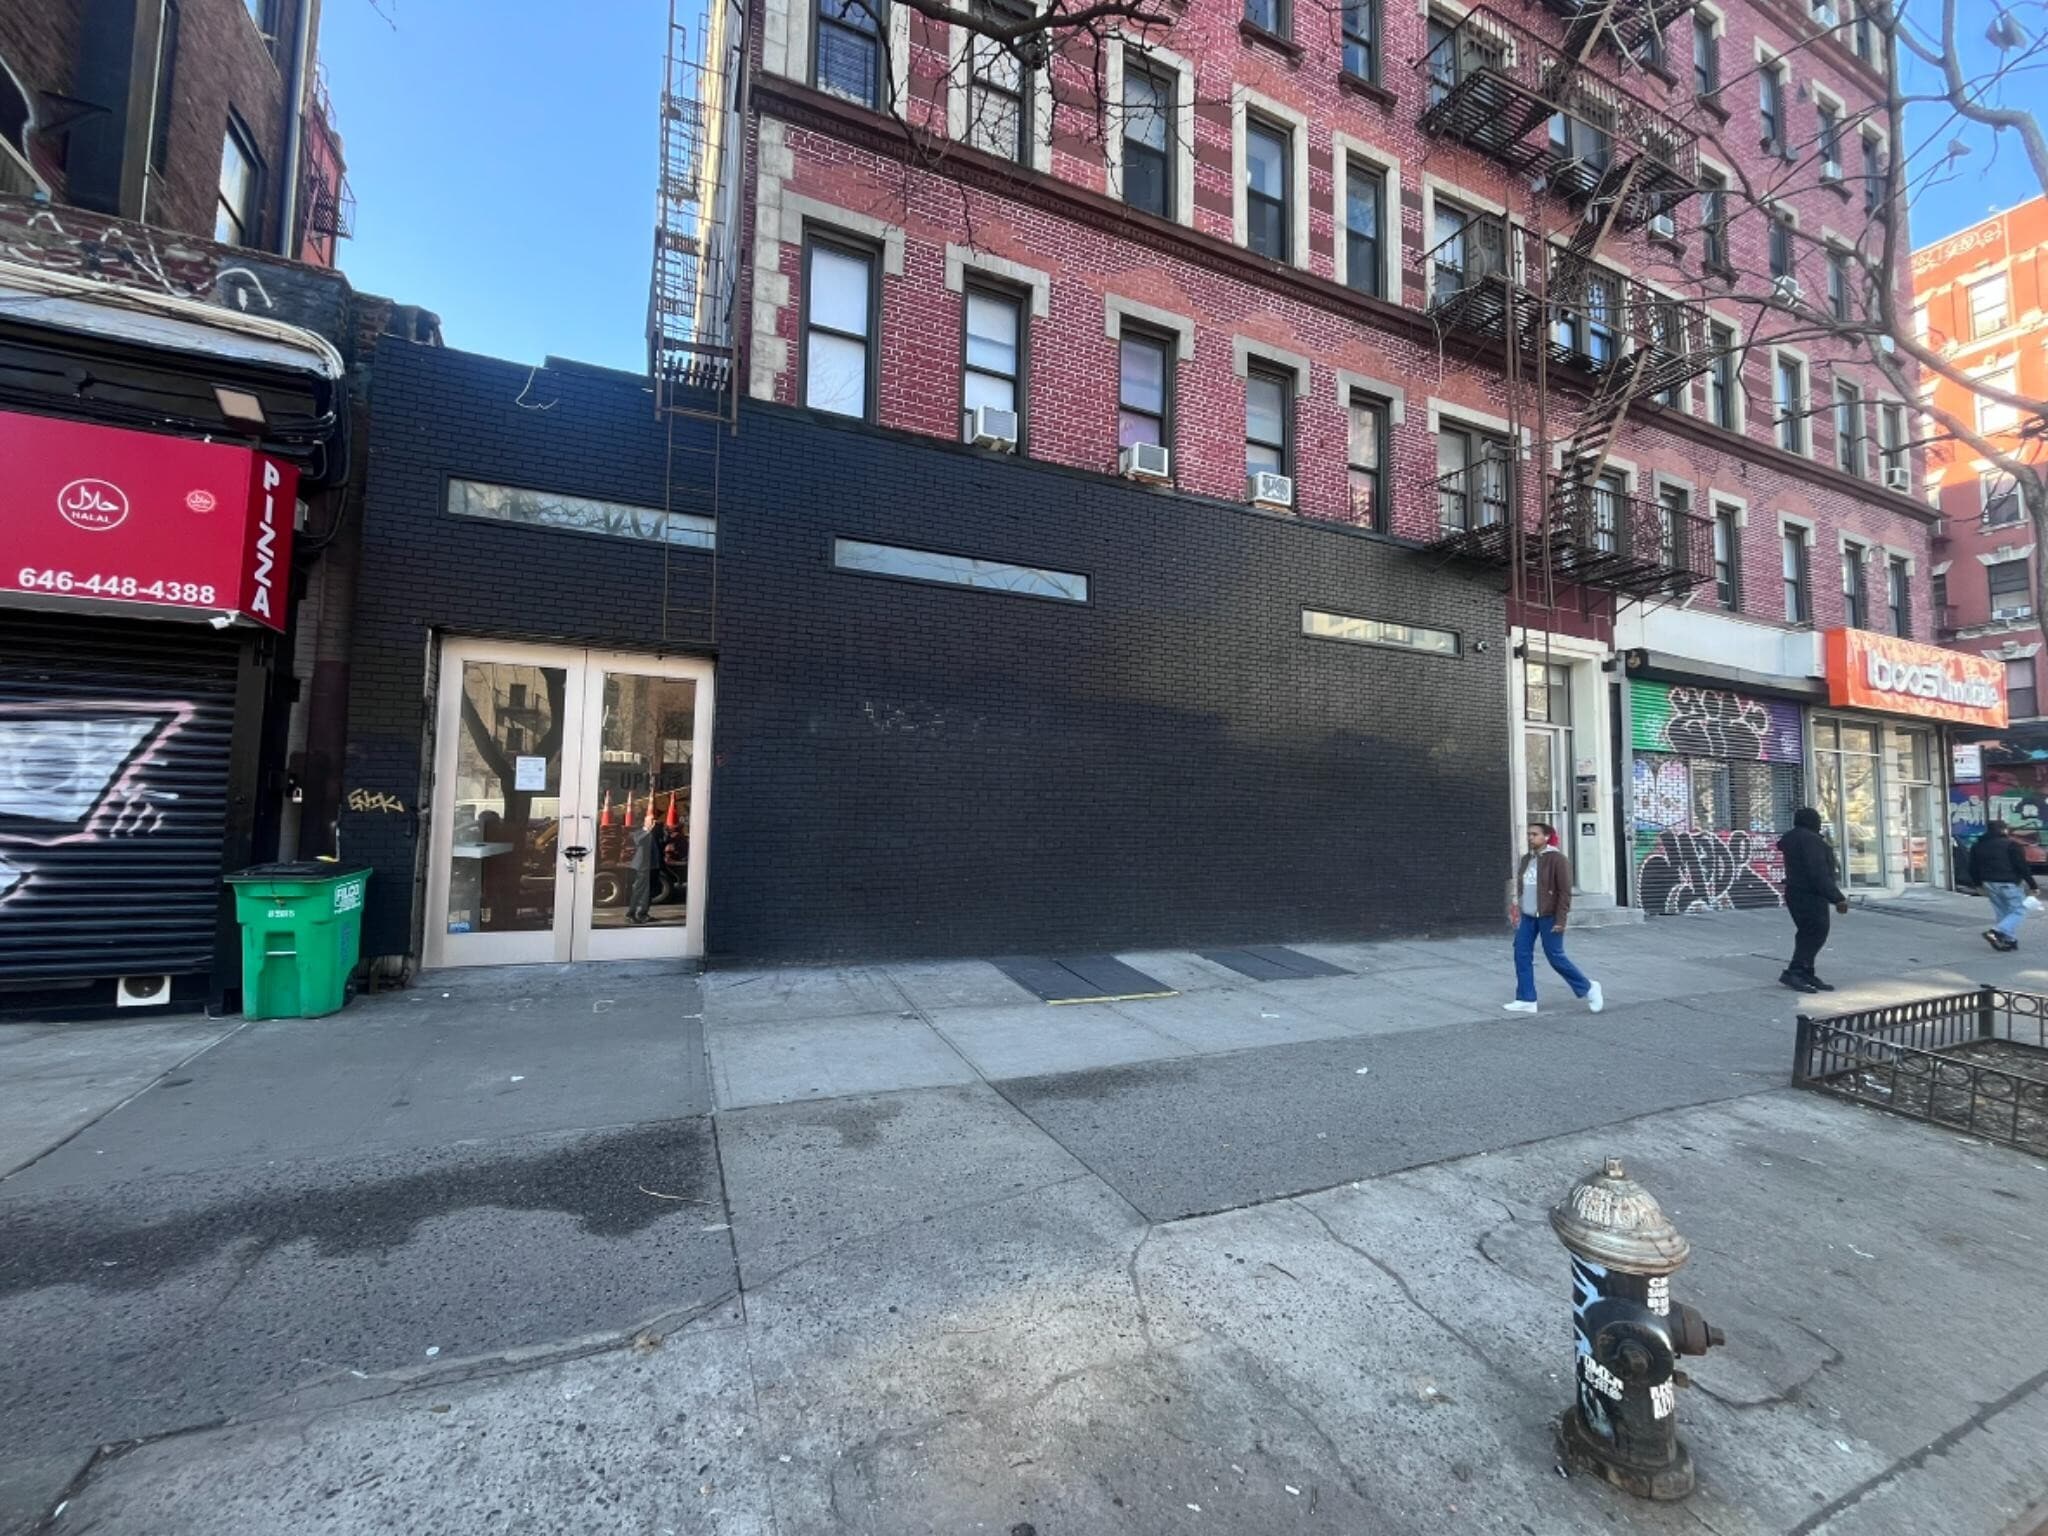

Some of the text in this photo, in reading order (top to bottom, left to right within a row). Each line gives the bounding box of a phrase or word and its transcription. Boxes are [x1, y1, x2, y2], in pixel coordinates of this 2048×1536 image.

[67, 485, 119, 511] حلال
[71, 510, 111, 523] HALAL
[252, 460, 280, 618] PIZZA
[18, 567, 216, 604] 646-448-4388
[1867, 649, 1947, 698] boost
